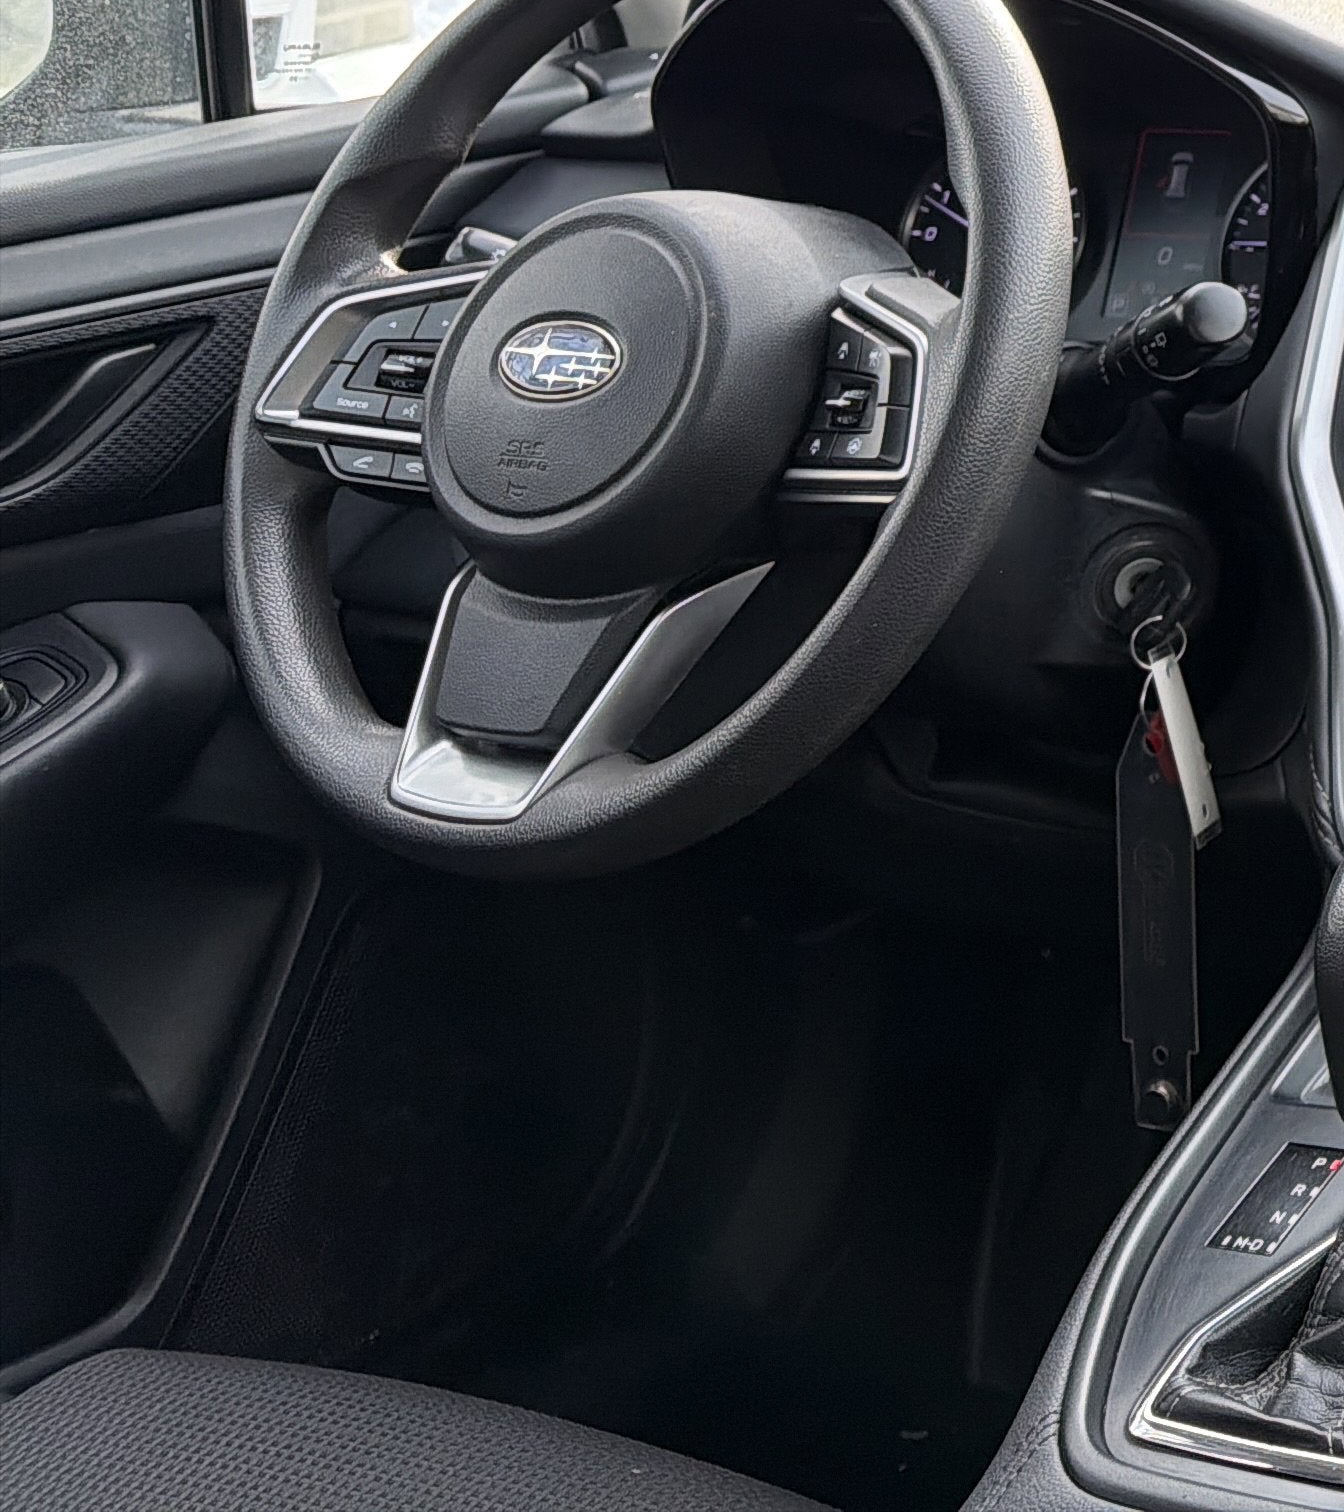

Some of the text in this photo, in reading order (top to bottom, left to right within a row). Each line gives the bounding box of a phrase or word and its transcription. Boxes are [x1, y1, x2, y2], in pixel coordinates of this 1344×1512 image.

[1256, 202, 1269, 216] 2
[924, 226, 938, 242] 0
[1157, 246, 1174, 266] 0
[336, 397, 369, 409] Source
[497, 457, 548, 472] AIRBAG
[1310, 1157, 1328, 1170] P
[1289, 1183, 1307, 1197] R
[1268, 1210, 1288, 1225] N
